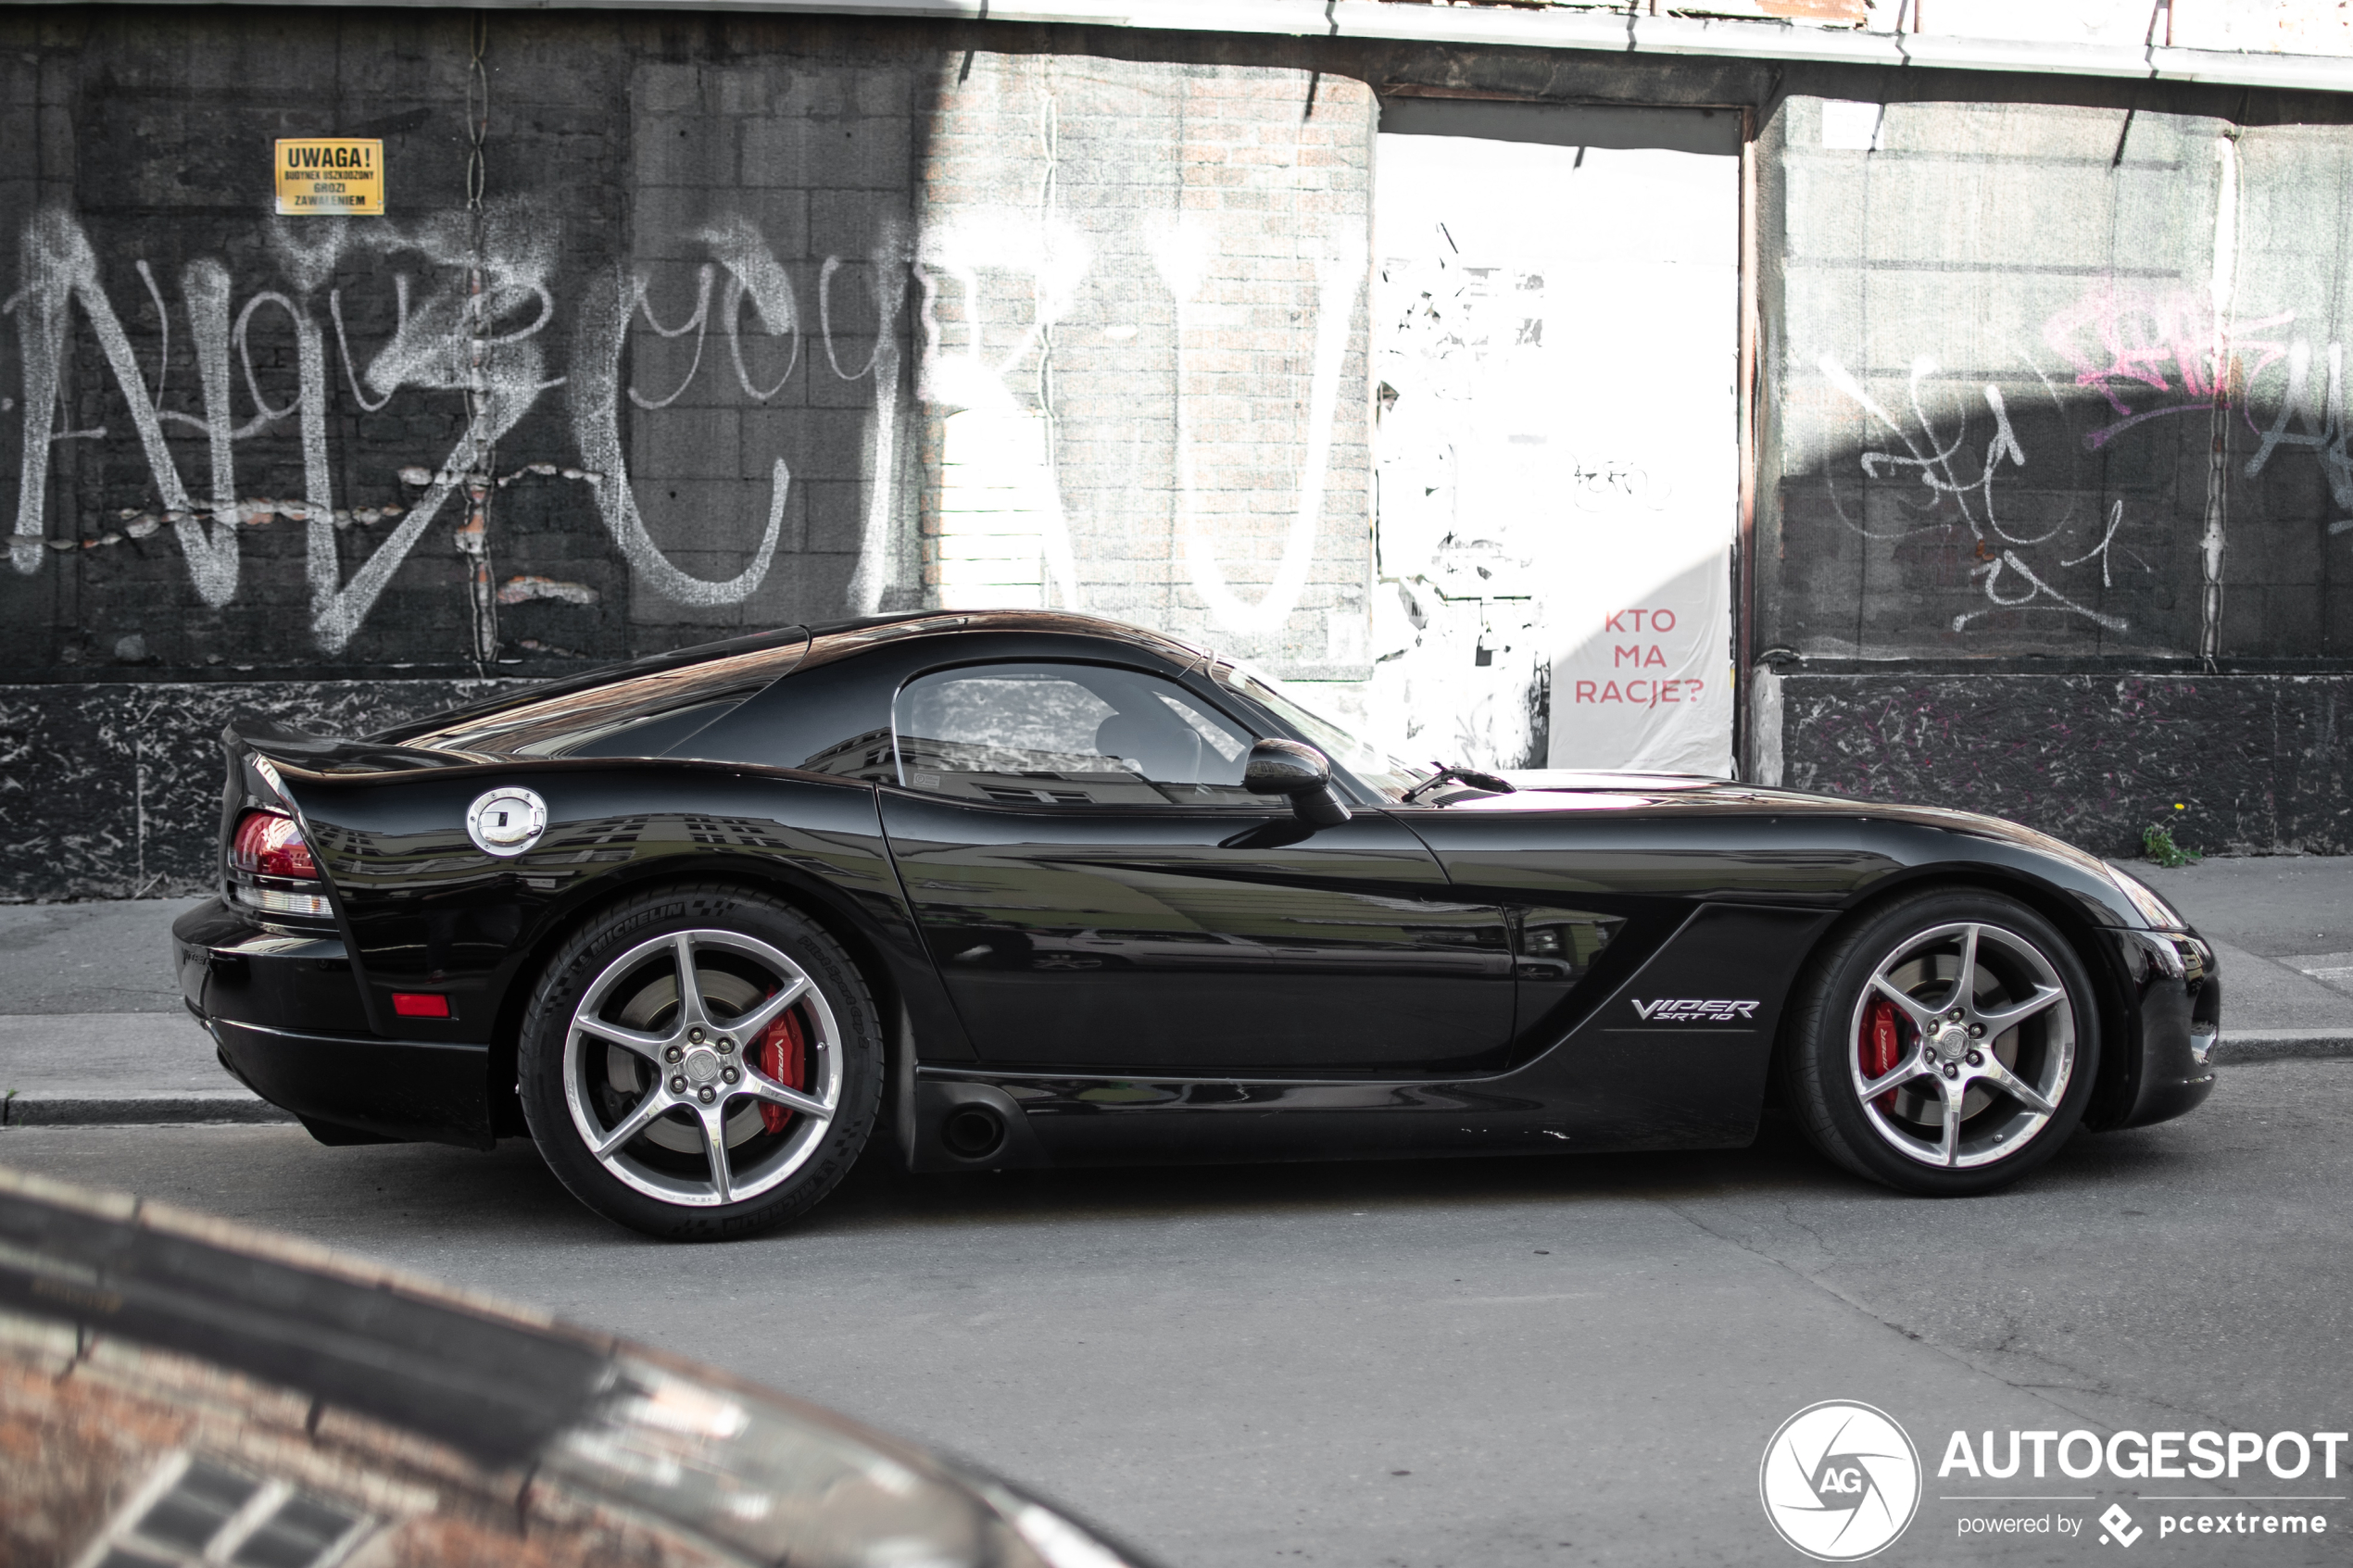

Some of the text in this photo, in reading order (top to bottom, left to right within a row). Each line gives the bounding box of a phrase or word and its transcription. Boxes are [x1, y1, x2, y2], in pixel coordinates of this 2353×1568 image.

[288, 147, 371, 168] UWAGA!
[284, 170, 321, 180] BUDYNEK
[314, 182, 346, 193] GROZI
[295, 195, 365, 206] ZAWALENIEM
[1605, 608, 1677, 633] KTO
[1615, 645, 1667, 668] MA
[1576, 679, 1705, 709] RACJE?
[589, 903, 684, 956] MICHELIN
[825, 965, 857, 1005] Sport
[858, 1036, 870, 1049] 2
[1630, 998, 1760, 1021] VIPER
[725, 1179, 817, 1231] MICHELIN
